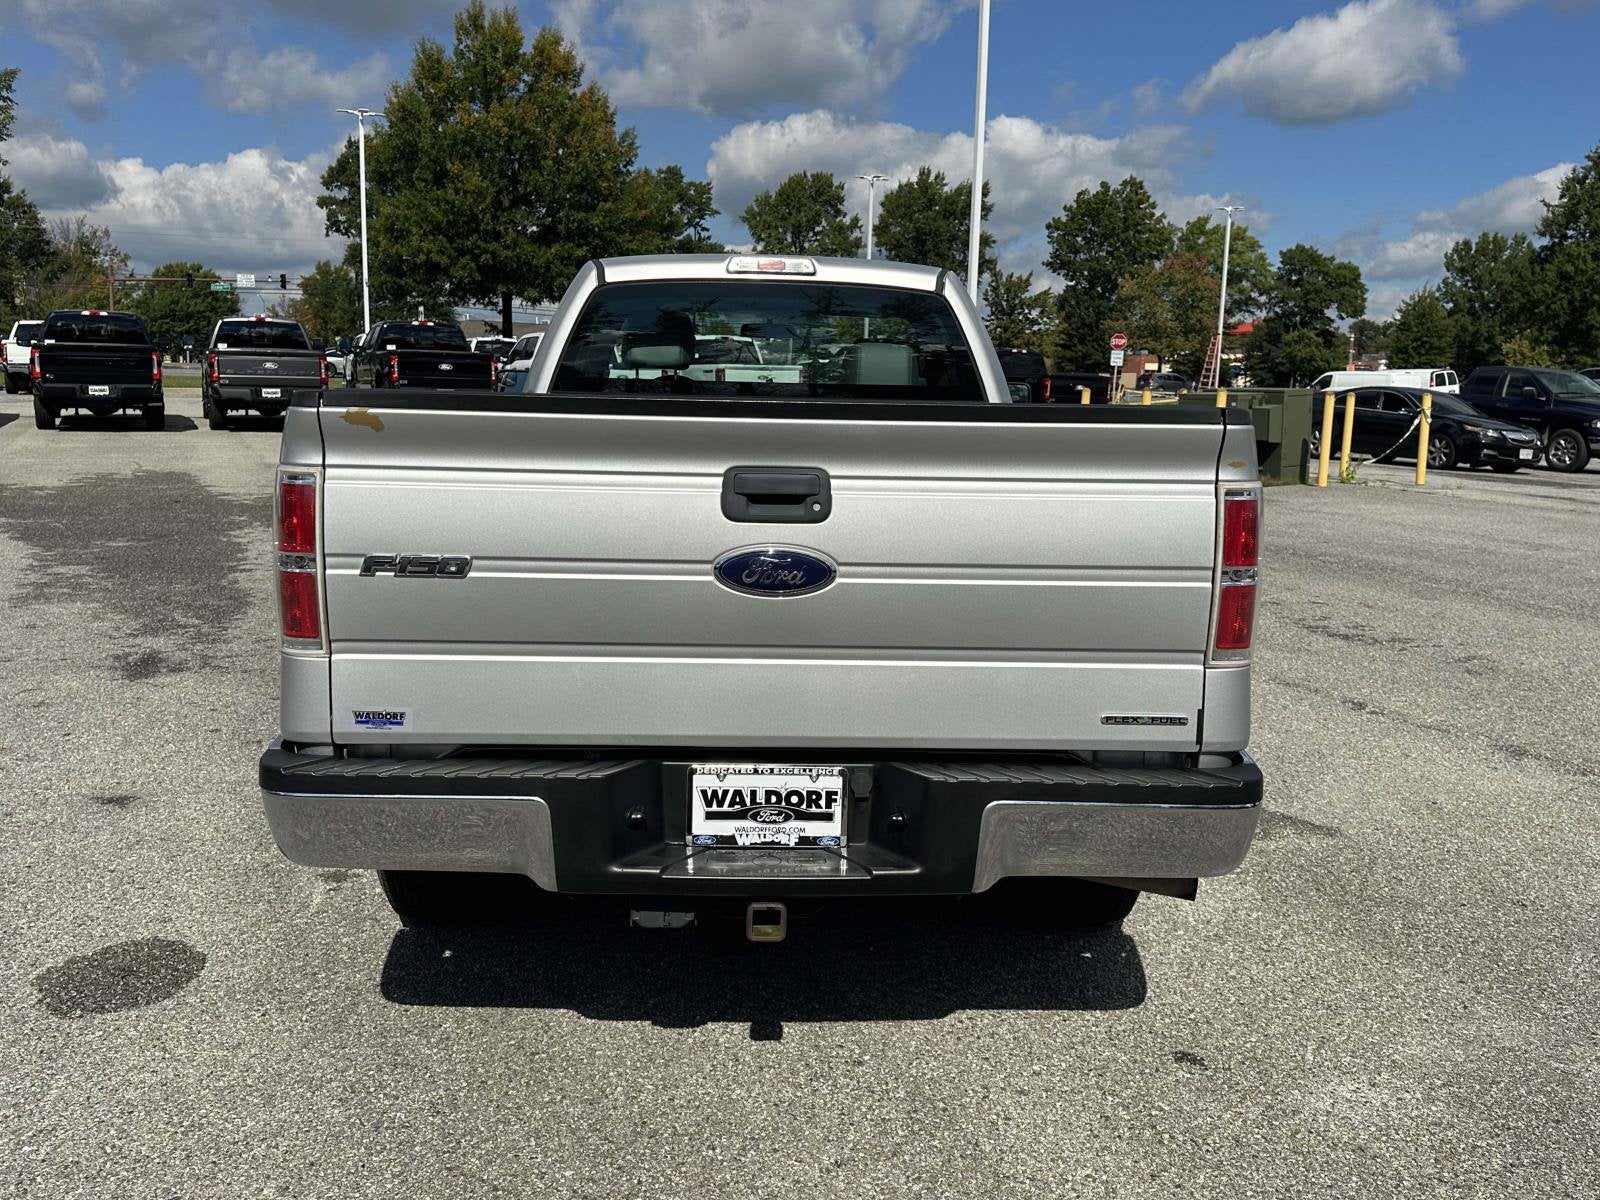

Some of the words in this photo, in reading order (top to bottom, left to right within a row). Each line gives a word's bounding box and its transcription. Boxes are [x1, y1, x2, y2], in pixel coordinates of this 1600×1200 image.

[741, 556, 807, 584] Ford
[354, 711, 405, 720] WALDORF
[695, 767, 753, 775] DEDICATED
[699, 789, 839, 809] WALDORF
[756, 810, 785, 823] Ford
[734, 826, 806, 834] WALDORFFORD.COM
[695, 836, 715, 844] Ford
[734, 833, 800, 847] WALDORF
[818, 837, 838, 845] Ford
